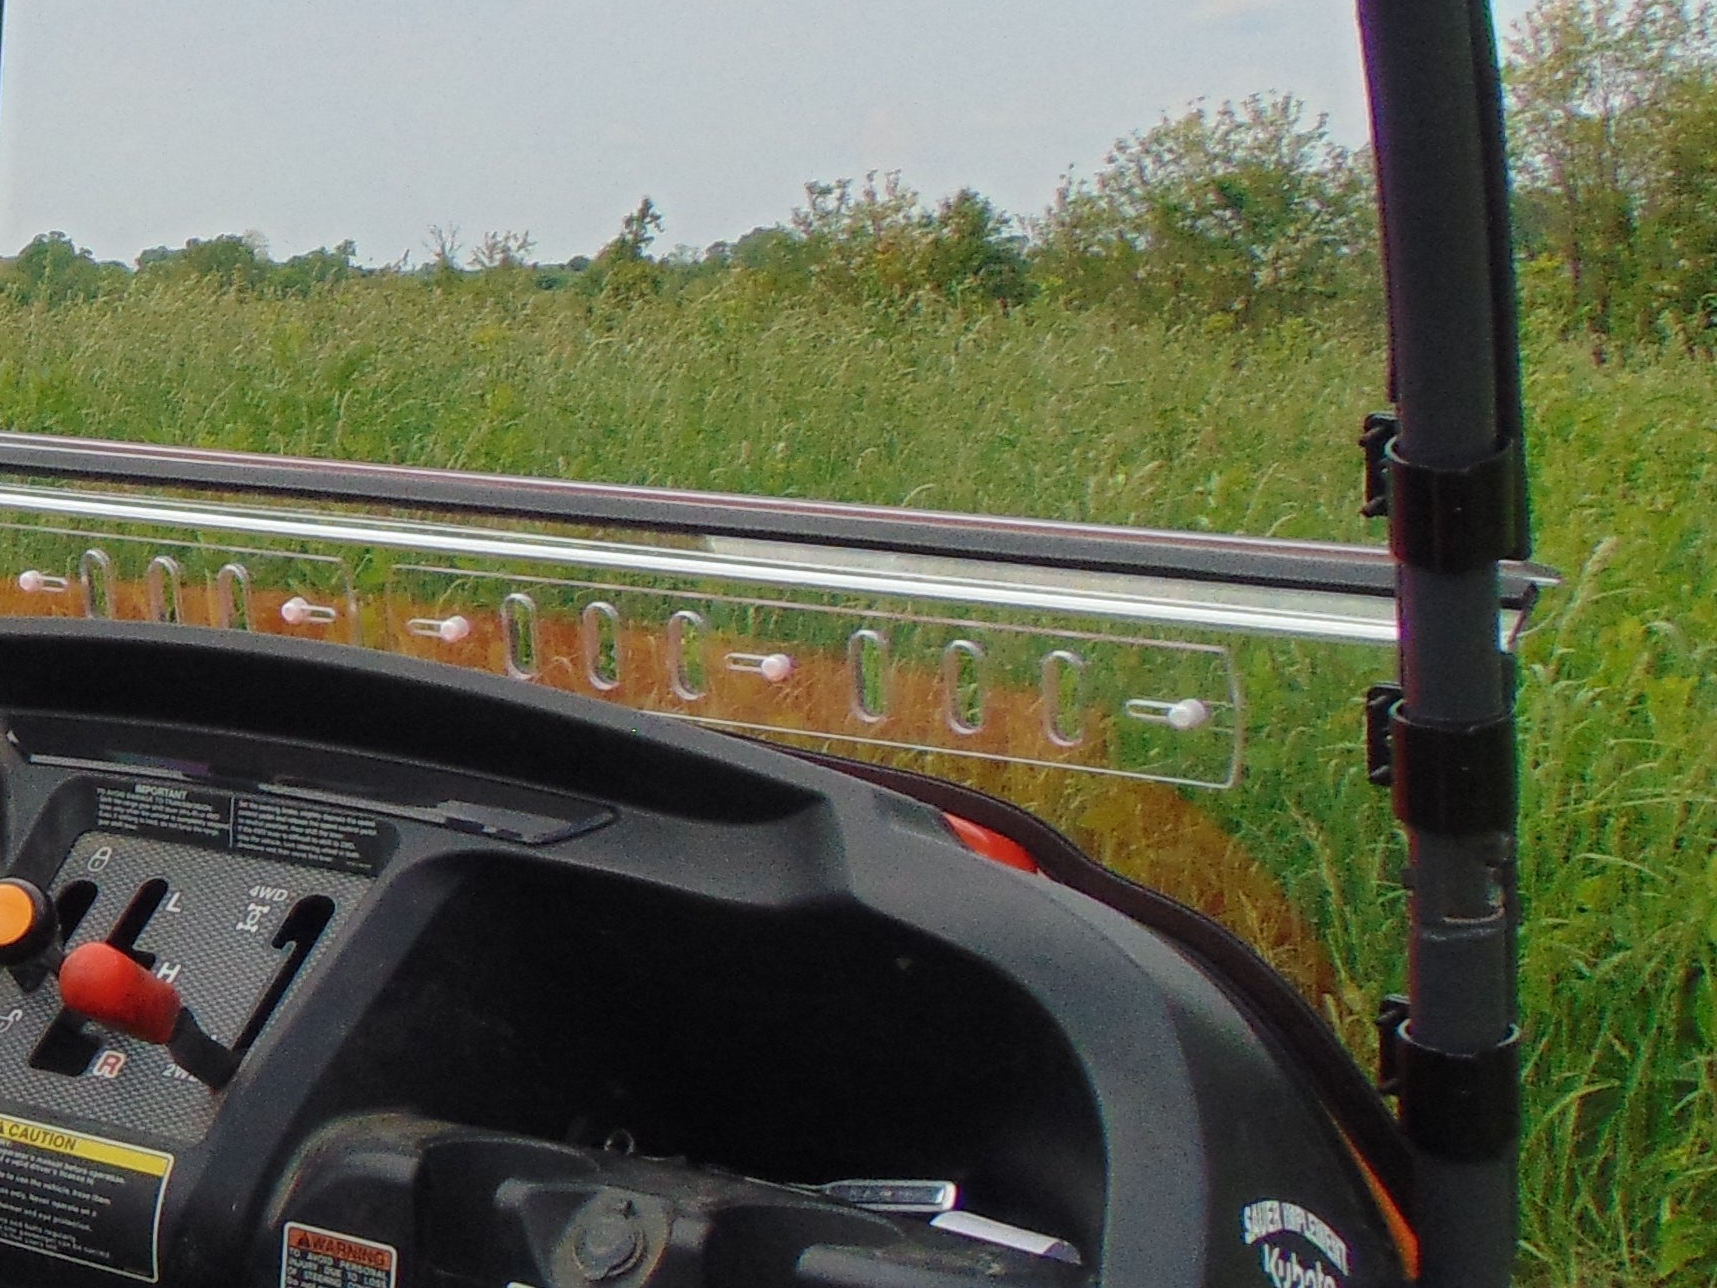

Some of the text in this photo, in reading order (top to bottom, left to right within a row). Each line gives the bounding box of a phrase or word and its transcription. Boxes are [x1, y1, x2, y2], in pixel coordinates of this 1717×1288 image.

[134, 784, 188, 800] IMPORTANT
[165, 892, 181, 912] L
[249, 885, 289, 902] 4WD
[156, 962, 181, 983] H
[94, 1050, 125, 1077] R
[9, 1124, 77, 1152] CAUTION
[312, 1235, 385, 1266] WARNING
[338, 1259, 386, 1279] PERSONAL
[346, 1271, 358, 1282] TO
[363, 1275, 386, 1288] LOSS
